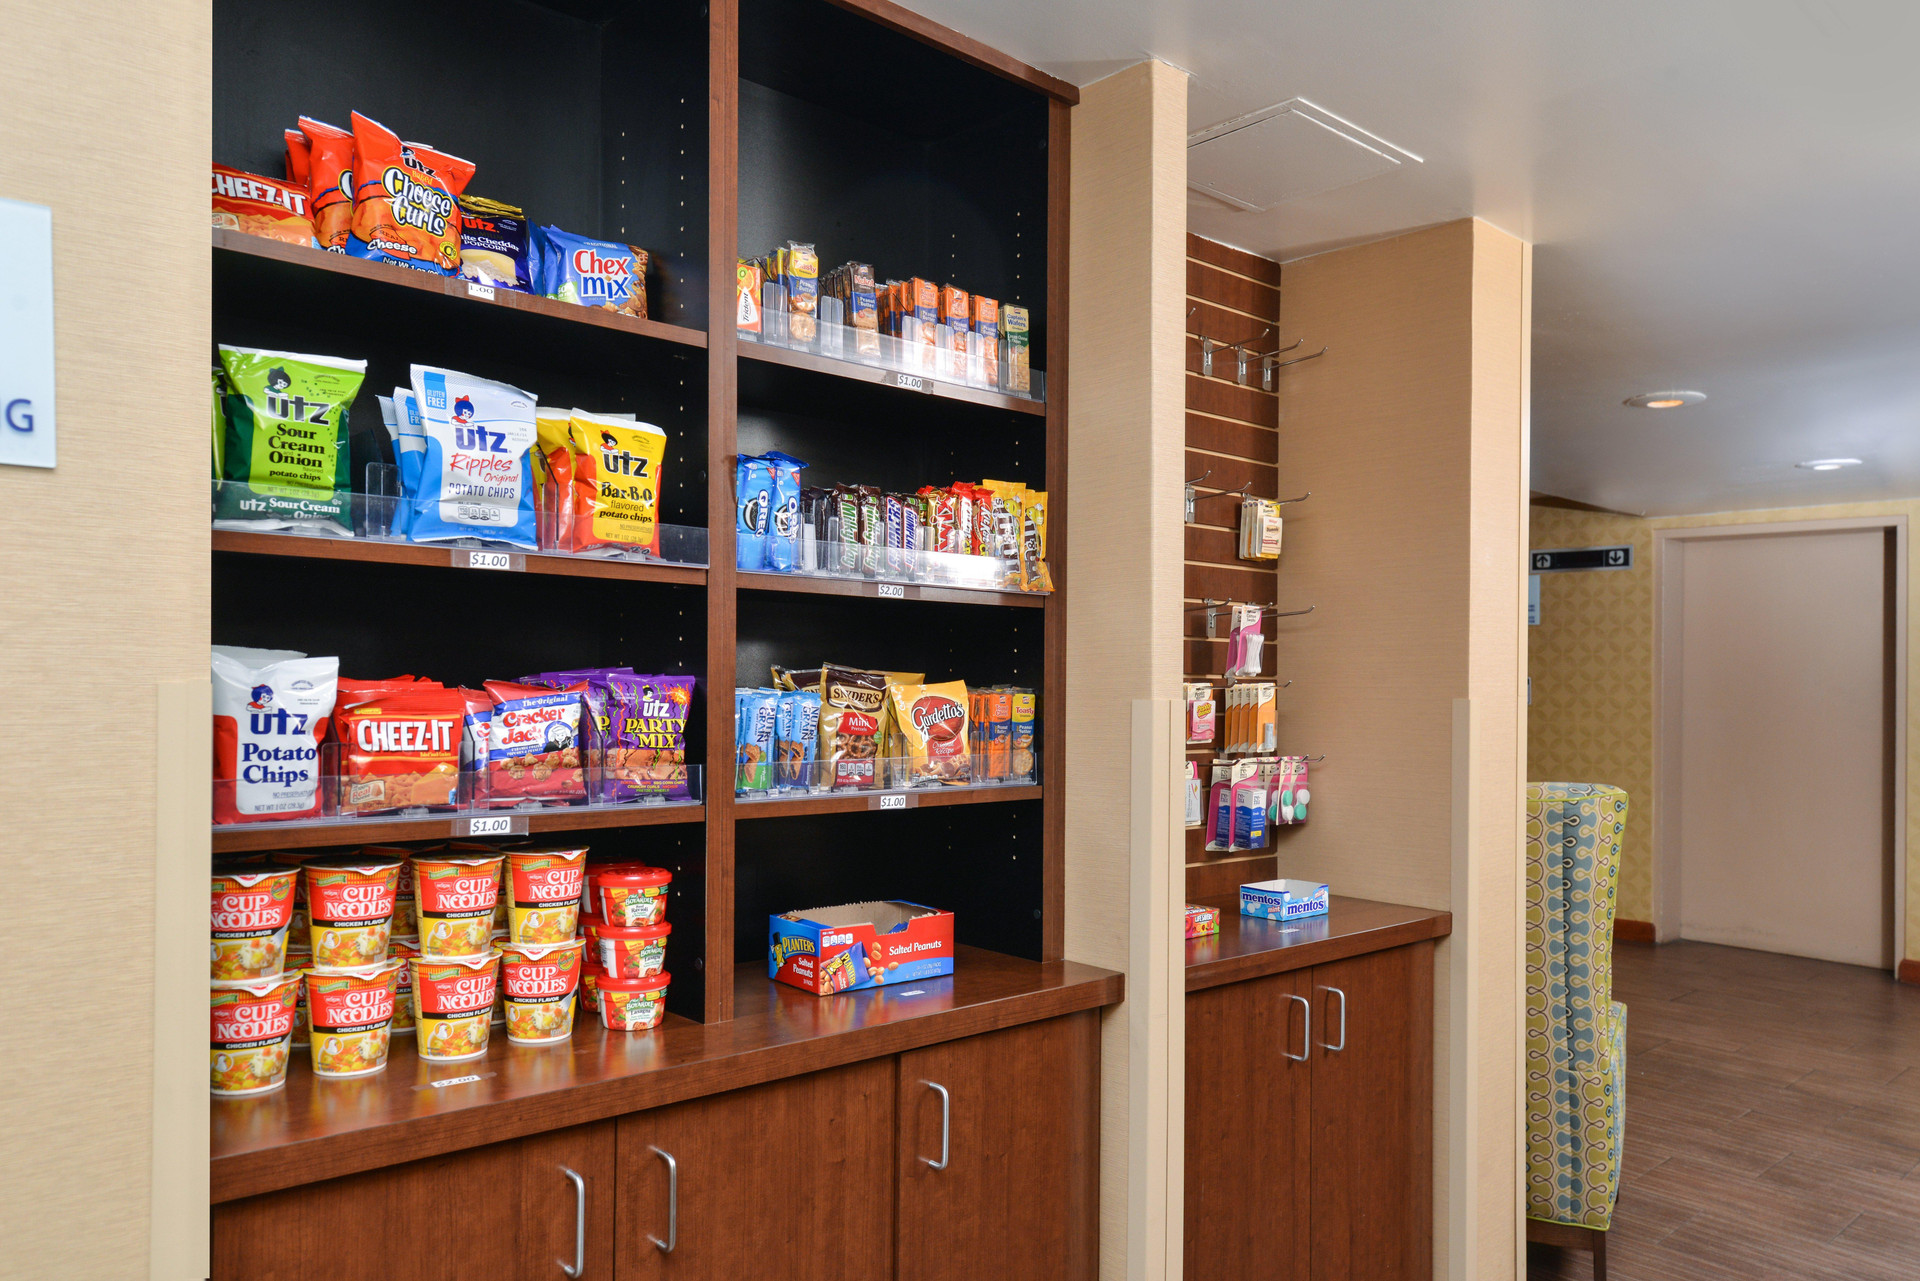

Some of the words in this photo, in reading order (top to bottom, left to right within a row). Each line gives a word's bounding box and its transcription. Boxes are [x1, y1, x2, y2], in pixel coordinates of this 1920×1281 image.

[384, 167, 451, 217] Cheese
[393, 195, 445, 237] Curls
[367, 239, 418, 254] Cheese
[464, 240, 508, 252] POPCORN
[574, 250, 629, 276] Chex
[898, 375, 922, 388] $1.00
[427, 397, 445, 408] FREE
[276, 423, 317, 440] Sour
[268, 436, 325, 454] Cream
[269, 451, 323, 468] Onion
[450, 453, 513, 477] Ripples
[269, 469, 298, 479] potato
[300, 471, 321, 482] chips
[483, 472, 519, 485] Original
[449, 482, 485, 497] POTATO
[487, 486, 515, 499] CHIPS
[269, 498, 300, 509] Sour
[300, 501, 341, 514] Cream
[611, 500, 645, 512] flavored
[755, 489, 770, 538] OREO
[599, 510, 629, 519] potato
[630, 512, 653, 523] chips
[471, 554, 508, 567] $1.00
[880, 584, 903, 597] $2.00
[536, 695, 568, 706] Original
[833, 688, 880, 704] SNYDER'S
[503, 708, 565, 728] Cracker
[1015, 706, 1034, 715] Toasty
[624, 719, 687, 733] PARTY
[756, 706, 767, 743] GRAIN
[800, 706, 812, 740] GRAIN
[808, 706, 820, 740] NUTRI
[849, 717, 869, 727] Mini
[911, 702, 965, 744] Gardetto's
[357, 719, 454, 752] CHEEZ-IT
[637, 734, 677, 748] MIX
[242, 743, 317, 762] Potato
[242, 764, 309, 787] Chips
[254, 804, 265, 812] NET
[881, 797, 905, 807] $1.00
[471, 819, 508, 833] $1.00
[546, 870, 579, 884] CUP
[342, 885, 385, 902] CUP
[454, 879, 492, 894] CUP
[222, 895, 270, 913] CUP
[439, 891, 497, 909] NOODLES
[1242, 892, 1281, 906] mentos
[326, 900, 392, 918] NOODLES
[1287, 900, 1324, 915] mentos
[364, 918, 385, 926] FLAVOR
[246, 929, 273, 938] FLAVOR
[782, 936, 815, 953] PLANTERS
[889, 943, 912, 956] Salted
[913, 940, 942, 953] Peanuts
[793, 964, 813, 978] Peanuts
[798, 957, 813, 969] Salted
[519, 967, 557, 980] CUP
[455, 976, 492, 995] CUP
[508, 978, 567, 994] NOODLES
[345, 990, 387, 1008] CUP
[439, 989, 496, 1010] NOODLES
[234, 1003, 281, 1022] CUP
[328, 1001, 392, 1024] NOODLES
[217, 1015, 290, 1039] NOODLES
[258, 1037, 282, 1047] FLAVOR
